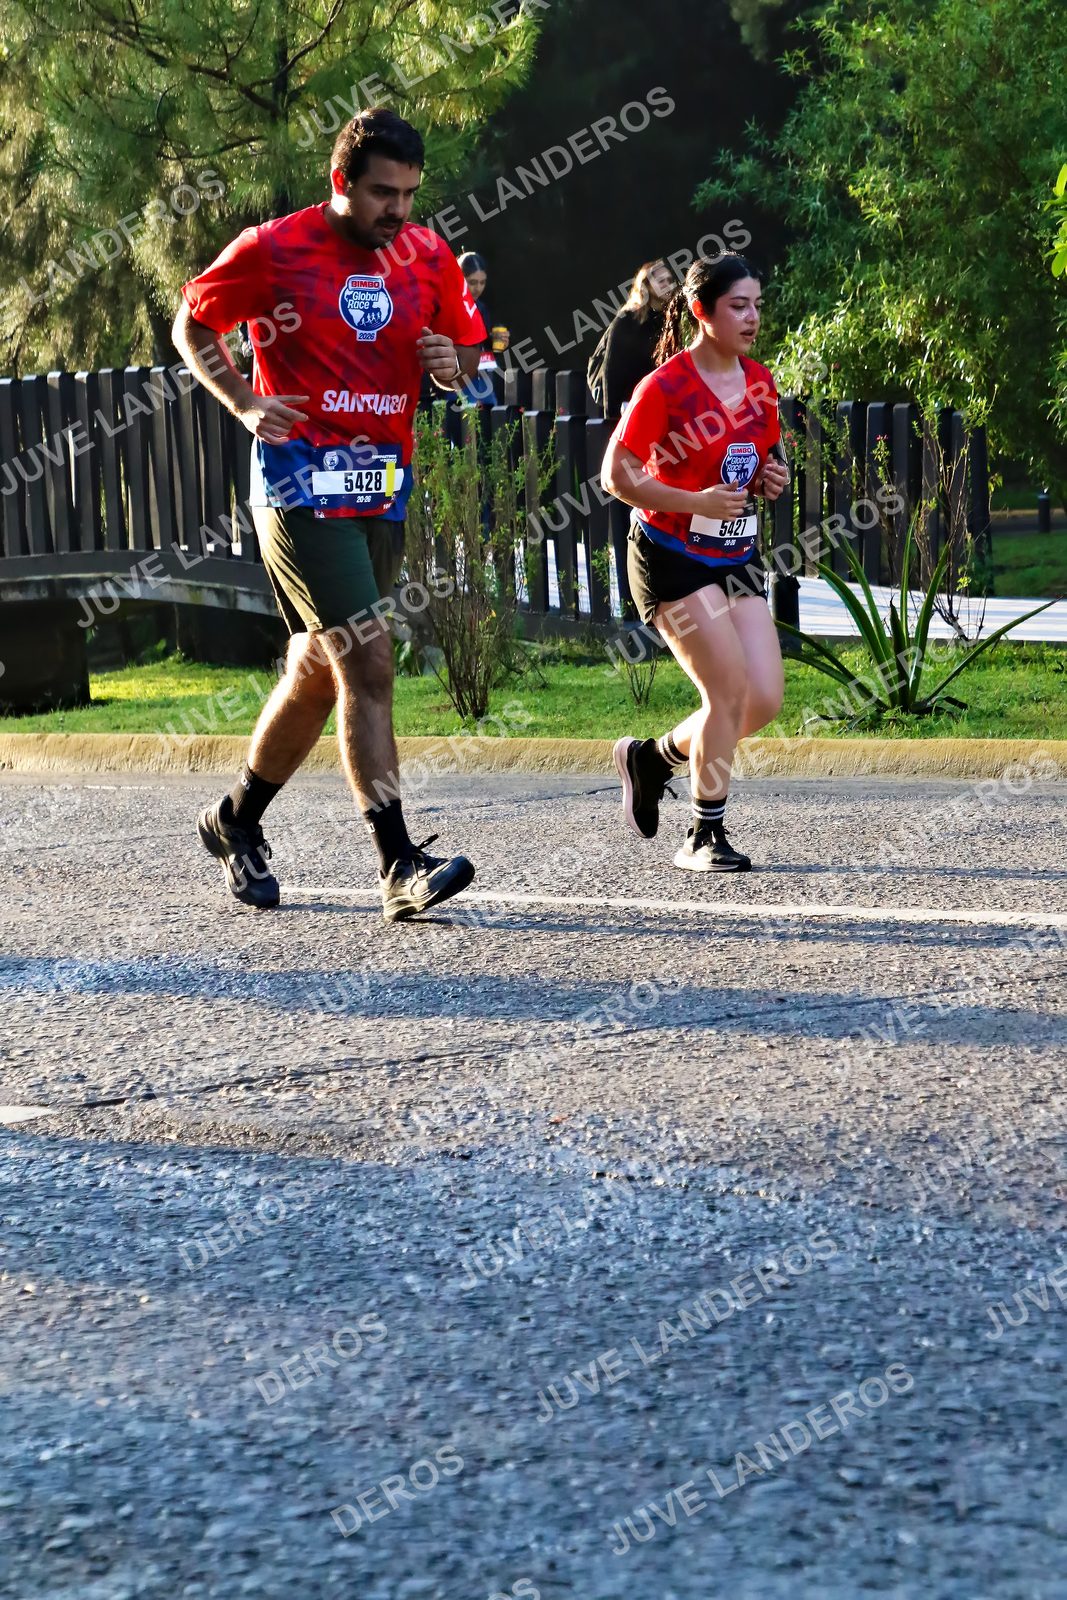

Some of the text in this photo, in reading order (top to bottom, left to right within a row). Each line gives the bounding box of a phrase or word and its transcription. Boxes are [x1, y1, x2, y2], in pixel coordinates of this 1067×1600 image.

[347, 300, 370, 309] Race
[352, 291, 379, 302] Global
[321, 389, 408, 416] SANTIAGO
[344, 471, 382, 492] 5428
